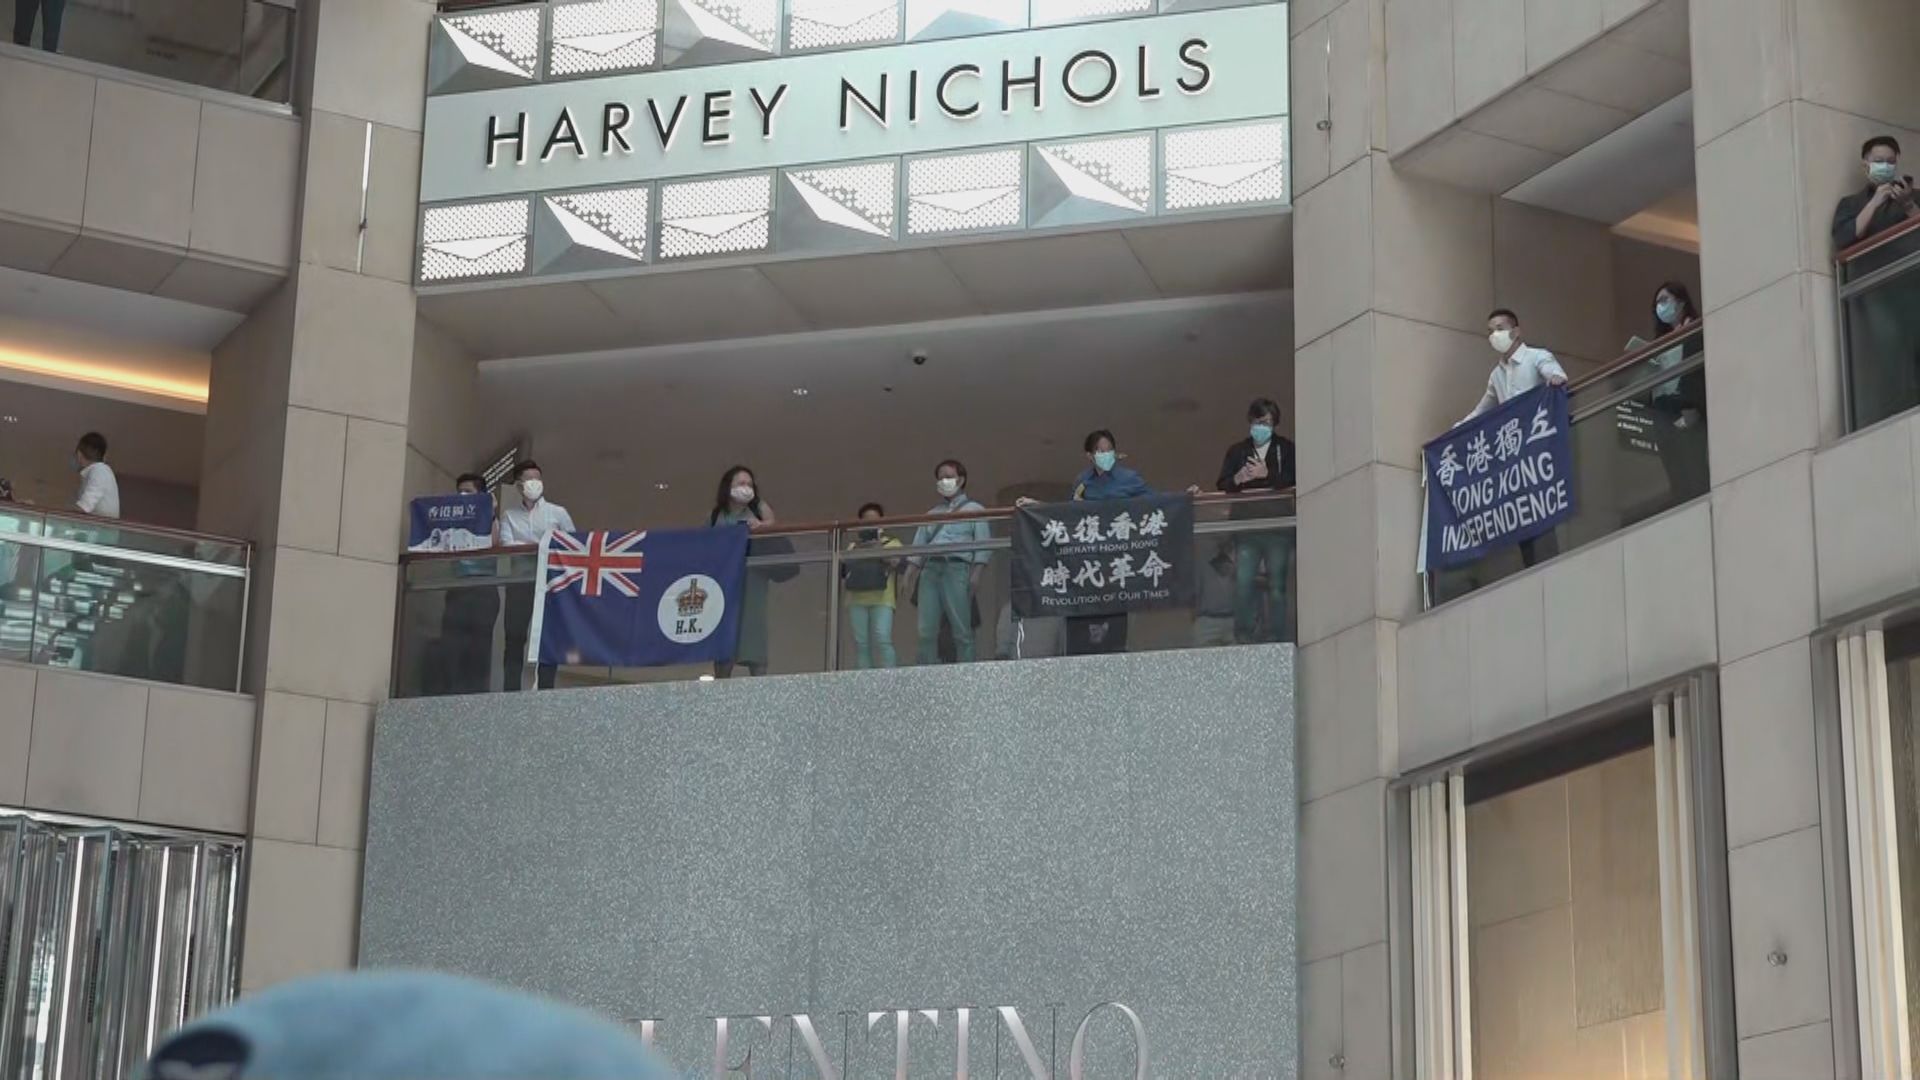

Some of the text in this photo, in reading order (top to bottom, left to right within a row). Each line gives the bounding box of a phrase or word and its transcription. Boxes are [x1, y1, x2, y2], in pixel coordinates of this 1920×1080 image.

[487, 38, 1212, 167] HARVEY NICHOLS
[1436, 403, 1557, 488] 香港獨立
[1499, 451, 1554, 499] KONG
[1040, 508, 1168, 547] 光復香港
[1442, 479, 1568, 553] INDEPENDENCE
[1099, 543, 1128, 552] HONG
[1131, 538, 1158, 549] KONG
[1040, 550, 1172, 593] 時代革命
[675, 618, 702, 635] H.K.
